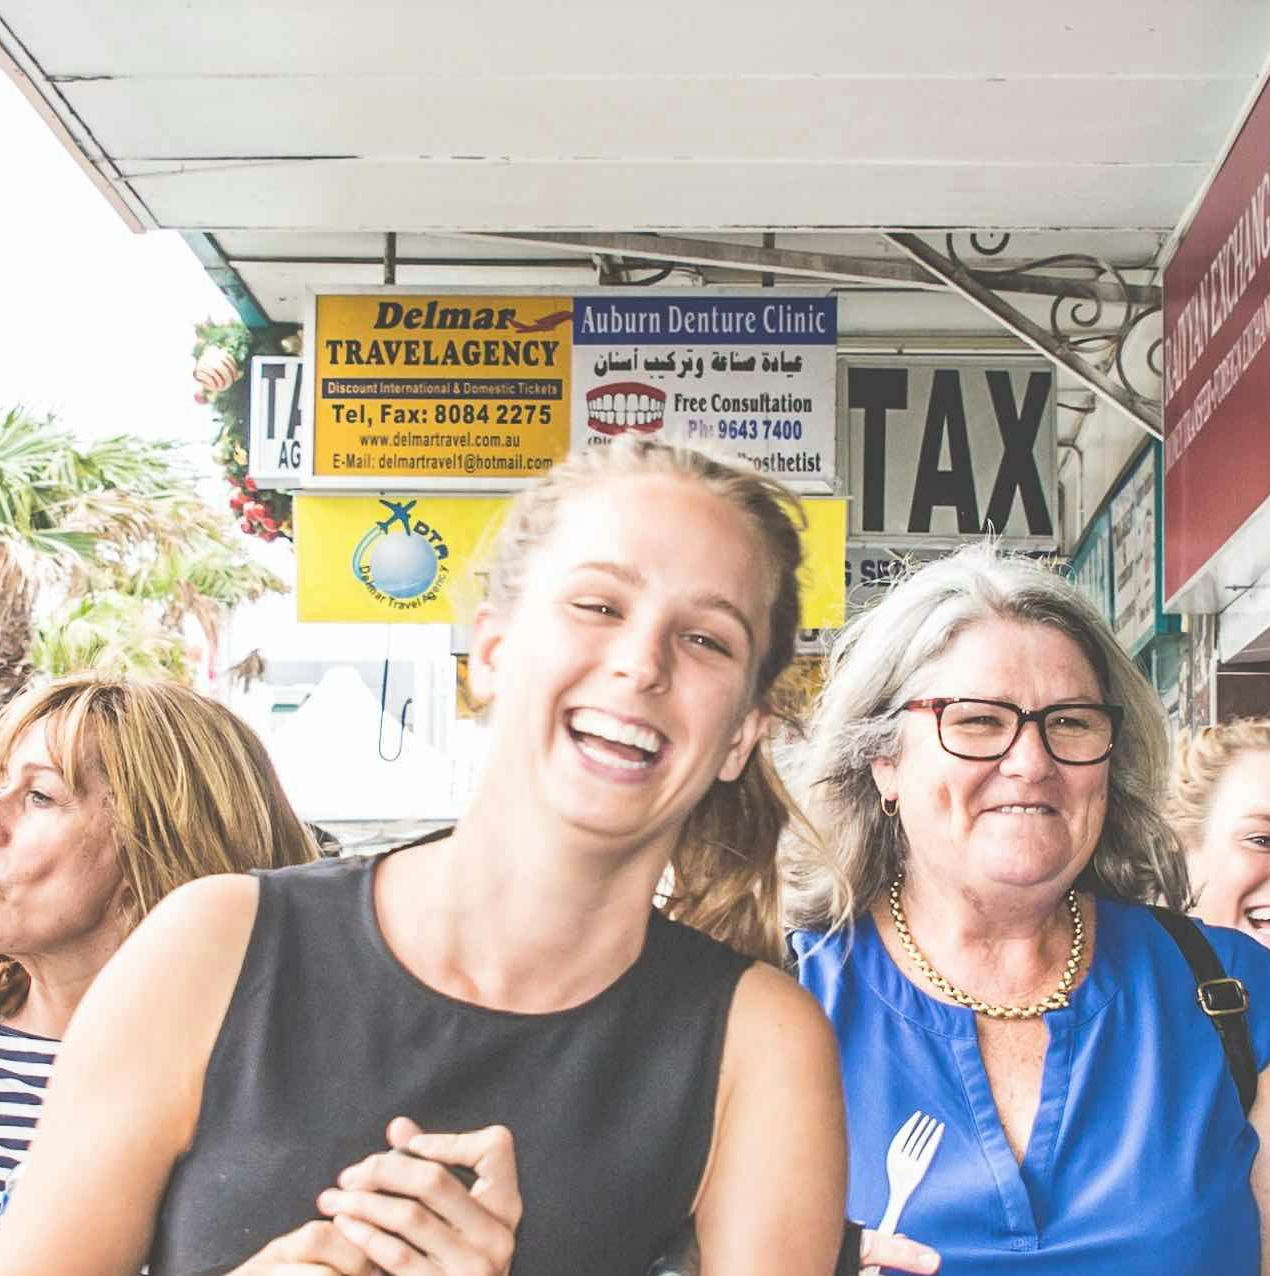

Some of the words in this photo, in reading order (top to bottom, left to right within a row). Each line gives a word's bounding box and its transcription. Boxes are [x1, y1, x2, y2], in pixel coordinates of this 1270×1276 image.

[373, 300, 517, 330] Delmar
[581, 305, 661, 334] Auburn
[668, 305, 757, 334] Denture
[763, 304, 827, 334] Clinic
[327, 382, 379, 395] Discount
[379, 382, 451, 395] International
[453, 382, 462, 395] &
[463, 382, 516, 396] Domestic
[518, 383, 558, 396] Tickets
[673, 393, 707, 413] Free
[711, 393, 813, 413] Consultation
[331, 404, 374, 427] Tel,
[380, 404, 428, 424] Fax:
[435, 404, 490, 425] 8084
[496, 405, 553, 425] 2275
[359, 432, 521, 448] www.delmartravel.com.au
[687, 420, 714, 440] Ph:
[718, 420, 759, 440] 9643
[762, 420, 803, 440] 7400
[847, 367, 1055, 536] TAX
[332, 454, 376, 470] E-Mail:
[737, 451, 822, 473] osthetist
[387, 598, 423, 611] Travel
